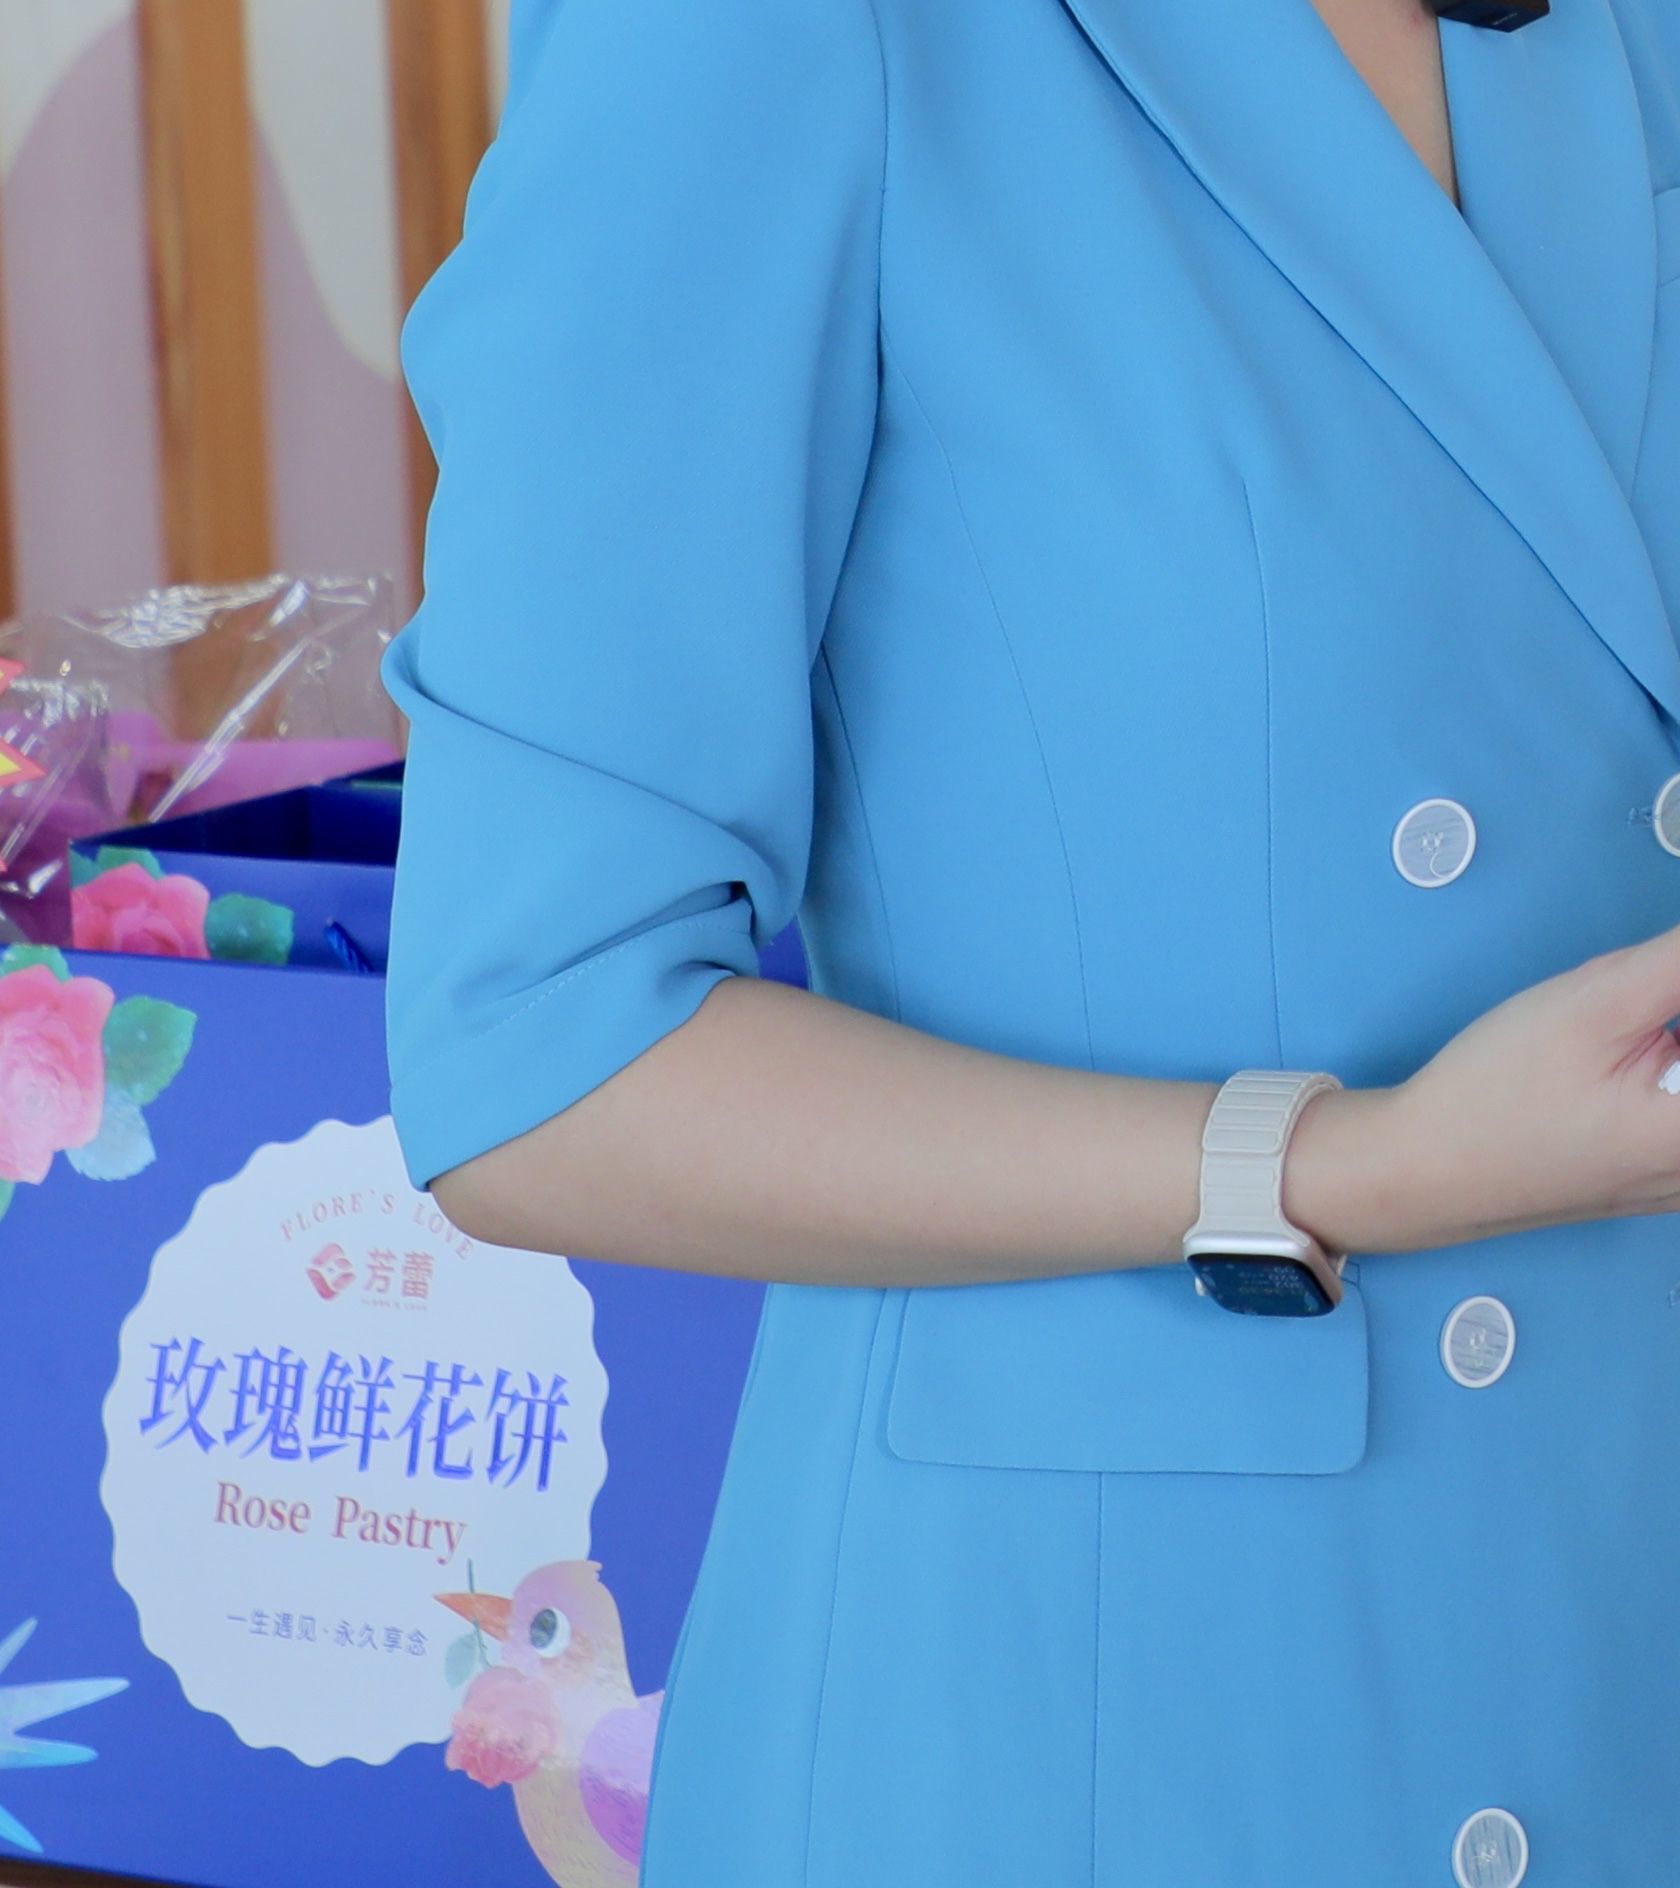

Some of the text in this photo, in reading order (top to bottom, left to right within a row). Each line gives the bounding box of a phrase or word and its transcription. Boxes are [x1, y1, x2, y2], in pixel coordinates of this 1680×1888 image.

[412, 1201, 474, 1260] LOVE
[362, 1247, 436, 1300] 芳蕾
[138, 1335, 572, 1493] 玫瑰鲜花饼
[213, 1479, 469, 1566] Rose Pastry
